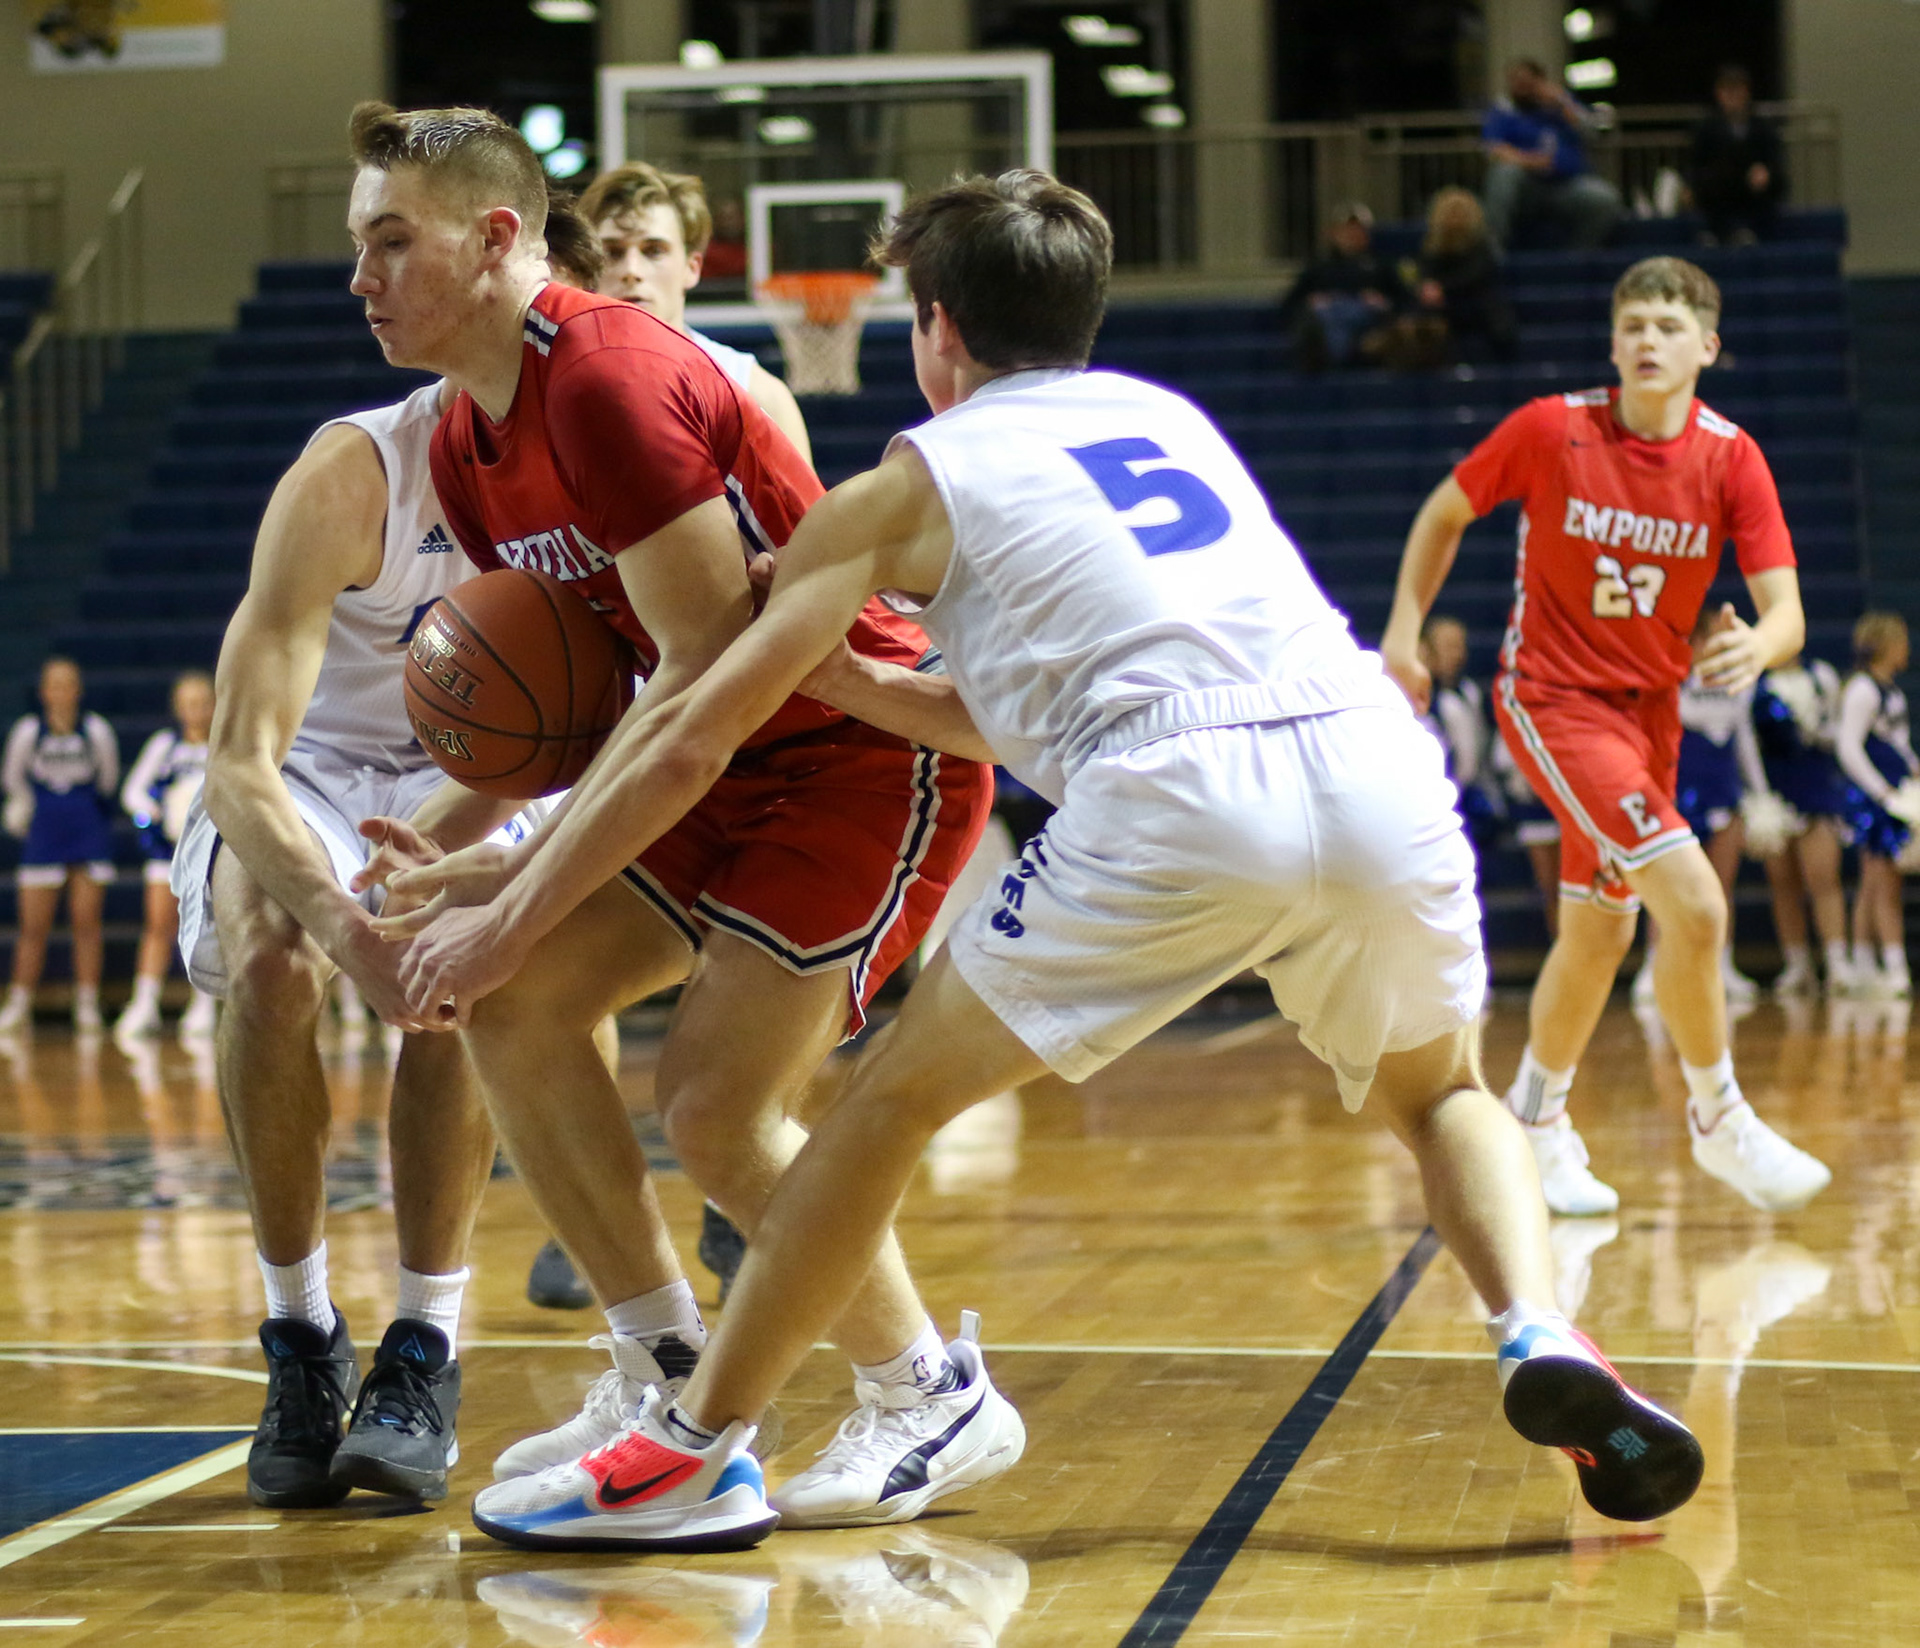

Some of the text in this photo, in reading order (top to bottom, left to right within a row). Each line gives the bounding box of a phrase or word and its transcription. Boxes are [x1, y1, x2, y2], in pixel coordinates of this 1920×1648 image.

[1060, 436, 1234, 558] 5
[1564, 497, 1709, 559] EMPORIA
[417, 543, 454, 554] adidas
[1592, 554, 1666, 619] 23
[1618, 791, 1662, 839] E
